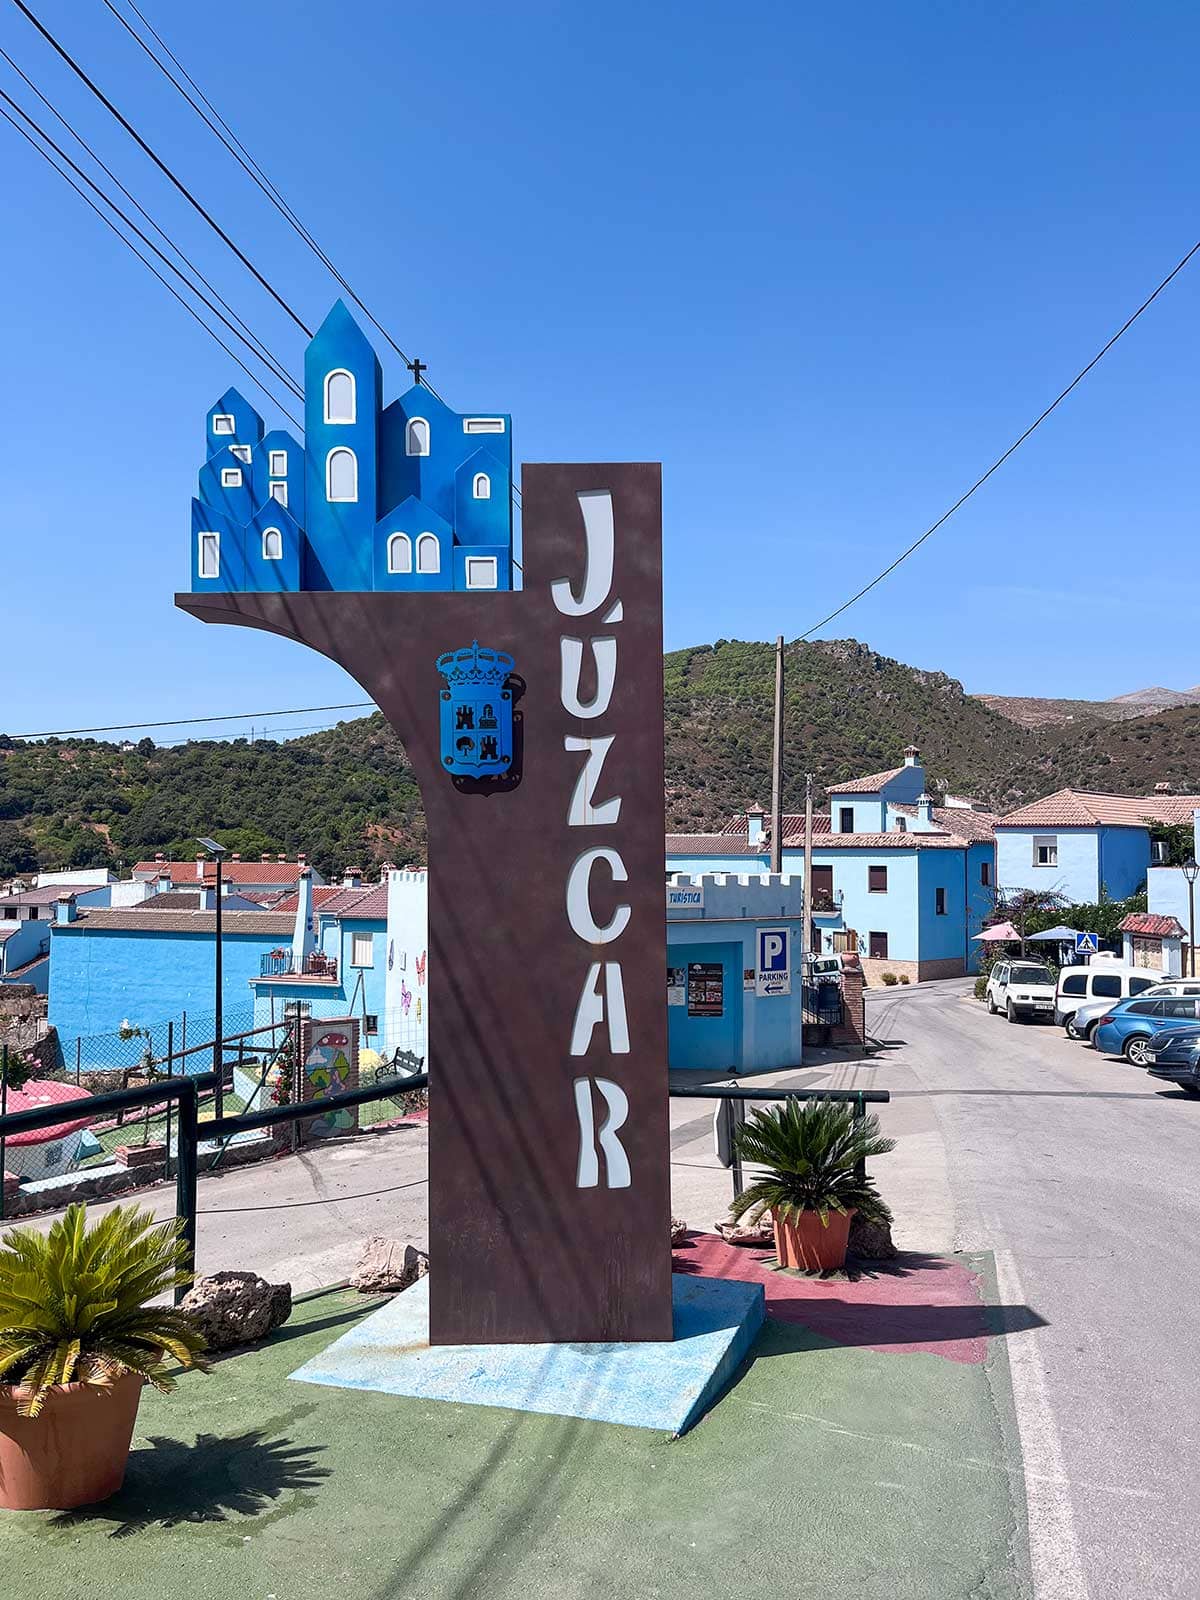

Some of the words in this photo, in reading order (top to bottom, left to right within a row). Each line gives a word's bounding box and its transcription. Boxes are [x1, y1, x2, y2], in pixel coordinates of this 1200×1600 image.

[670, 889, 701, 904] TURÍSTICA
[764, 935, 783, 968] P
[759, 972, 789, 982] PARKING
